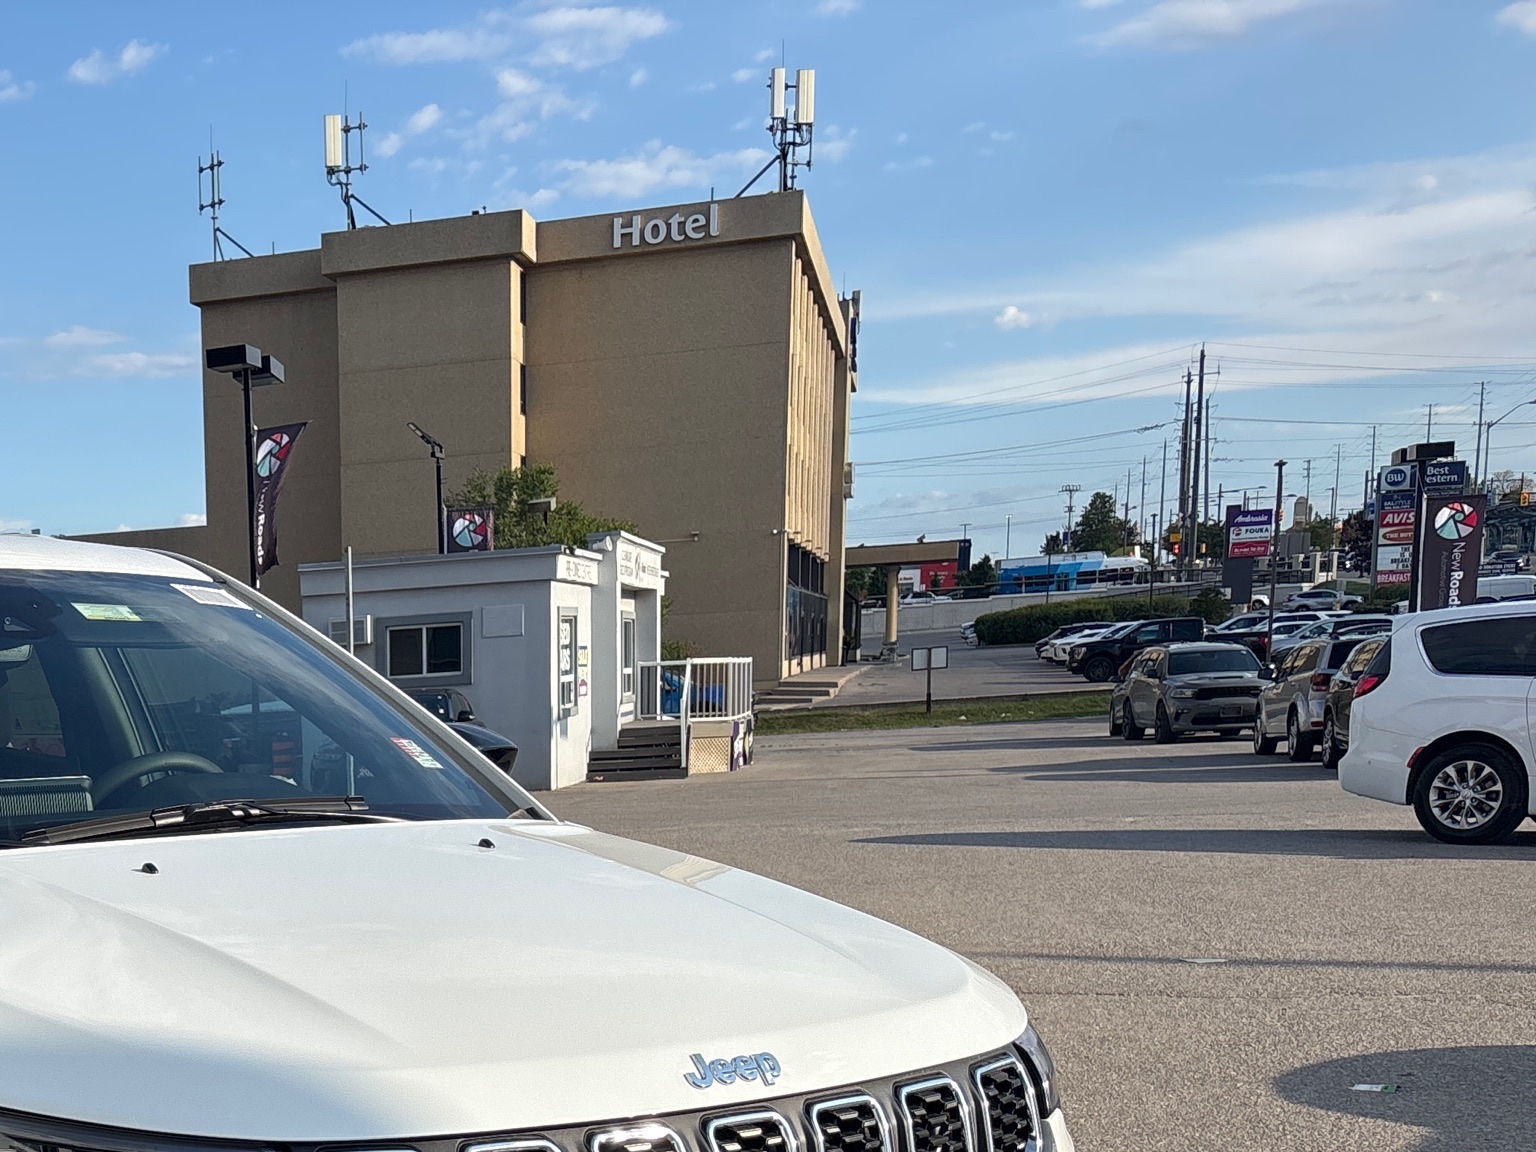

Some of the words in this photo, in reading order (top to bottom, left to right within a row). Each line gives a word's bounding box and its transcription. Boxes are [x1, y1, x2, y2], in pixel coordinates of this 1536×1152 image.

[613, 203, 720, 249] Hotel
[1426, 466, 1449, 475] Best
[1386, 472, 1405, 482] BW
[1425, 474, 1459, 483] estern
[1383, 511, 1415, 525] AVIS
[1377, 573, 1411, 583] BREAKFAST
[683, 1052, 781, 1090] Jeep
